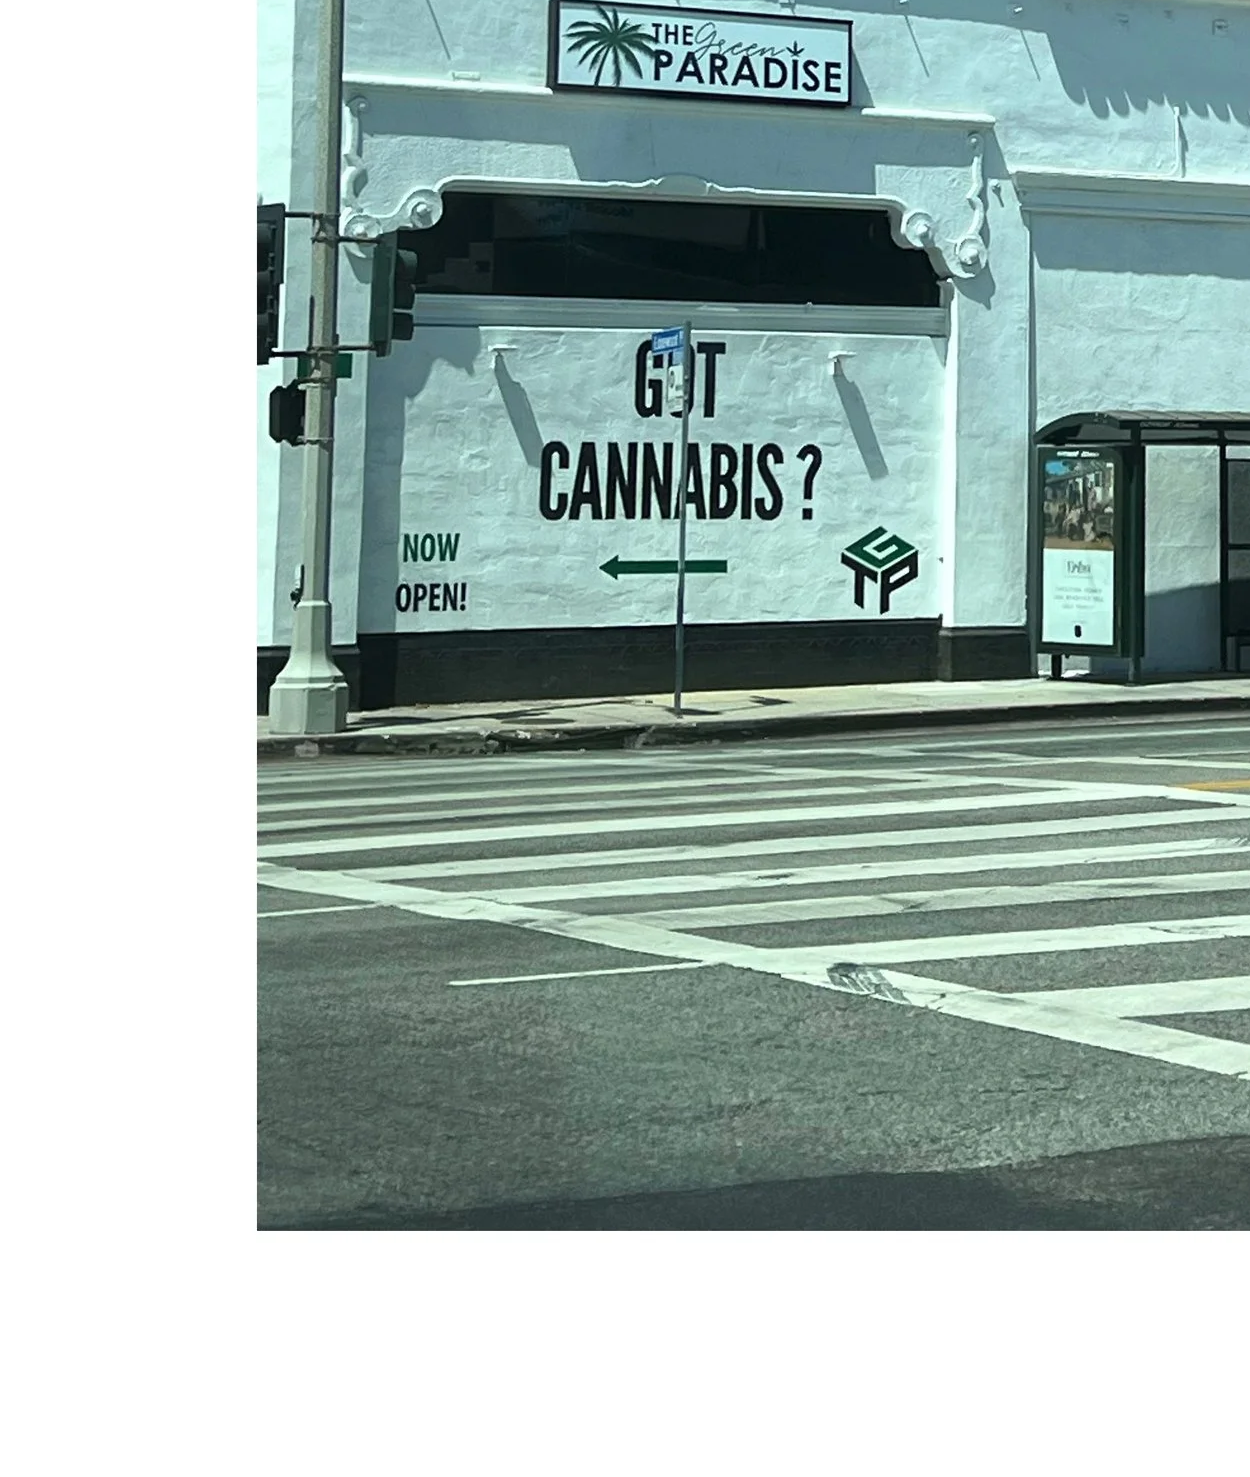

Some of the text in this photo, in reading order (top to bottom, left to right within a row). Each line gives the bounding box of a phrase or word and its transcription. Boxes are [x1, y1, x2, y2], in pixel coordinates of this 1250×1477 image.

[652, 21, 786, 60] THE Green
[653, 49, 842, 93] PARADISE
[403, 533, 460, 562] NOW
[395, 582, 467, 612] OPEN!
